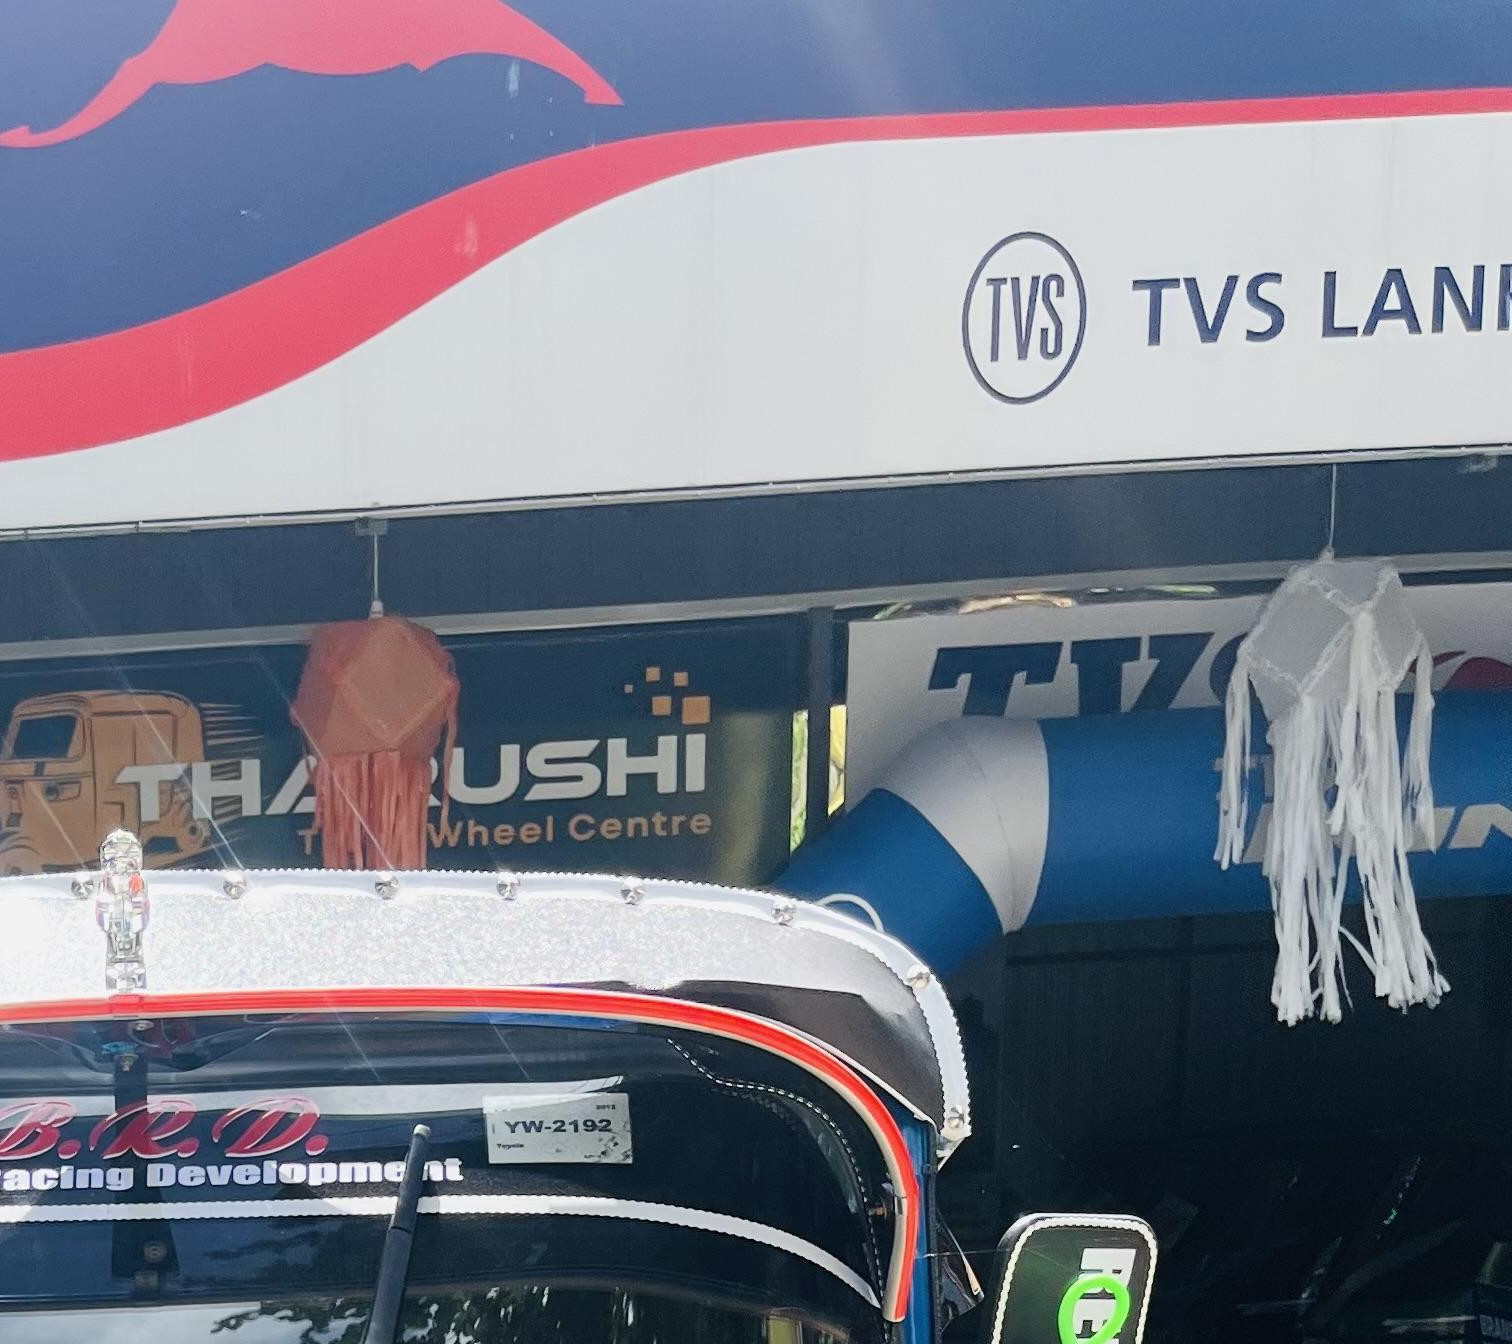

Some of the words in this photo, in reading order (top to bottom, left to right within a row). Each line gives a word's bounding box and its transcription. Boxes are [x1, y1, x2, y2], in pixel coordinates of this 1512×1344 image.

[986, 273, 1065, 362] TVS
[1131, 272, 1286, 346] TVS
[1321, 264, 1512, 338] LAN
[114, 734, 706, 820] THUSHI
[428, 815, 554, 849] Wheel
[568, 810, 713, 842] Centre
[504, 1118, 612, 1134] YW-2192
[146, 1157, 465, 1188] Development
